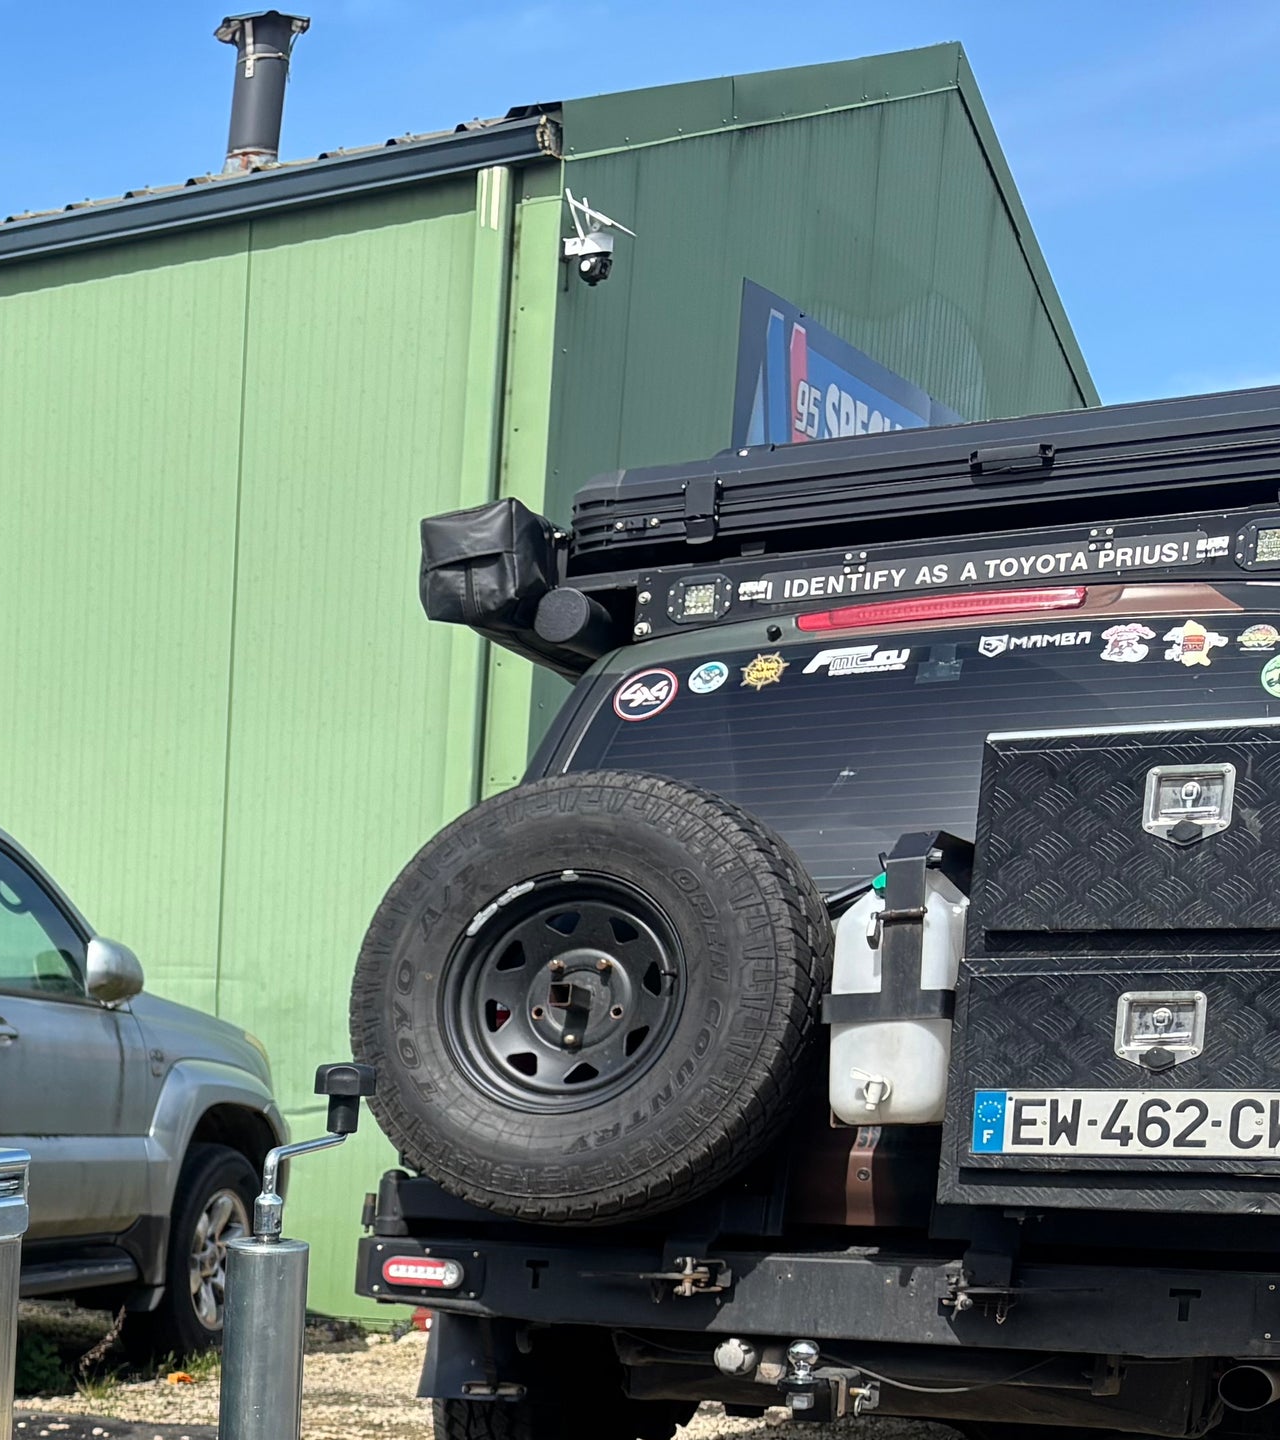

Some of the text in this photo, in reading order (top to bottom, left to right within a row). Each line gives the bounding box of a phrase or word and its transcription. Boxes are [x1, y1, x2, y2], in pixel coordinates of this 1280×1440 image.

[794, 379, 822, 439] 95
[784, 568, 907, 598] IDENTIFY
[915, 565, 948, 585] AS
[960, 561, 977, 581] A
[984, 551, 1088, 579] TOYOTA
[1098, 541, 1190, 569] PRIUS!
[1009, 631, 1092, 650] MAMBA
[671, 867, 729, 983] OPEN
[392, 958, 439, 1103] TOYO
[561, 997, 723, 1155] COUNTRY
[982, 1129, 994, 1144] F
